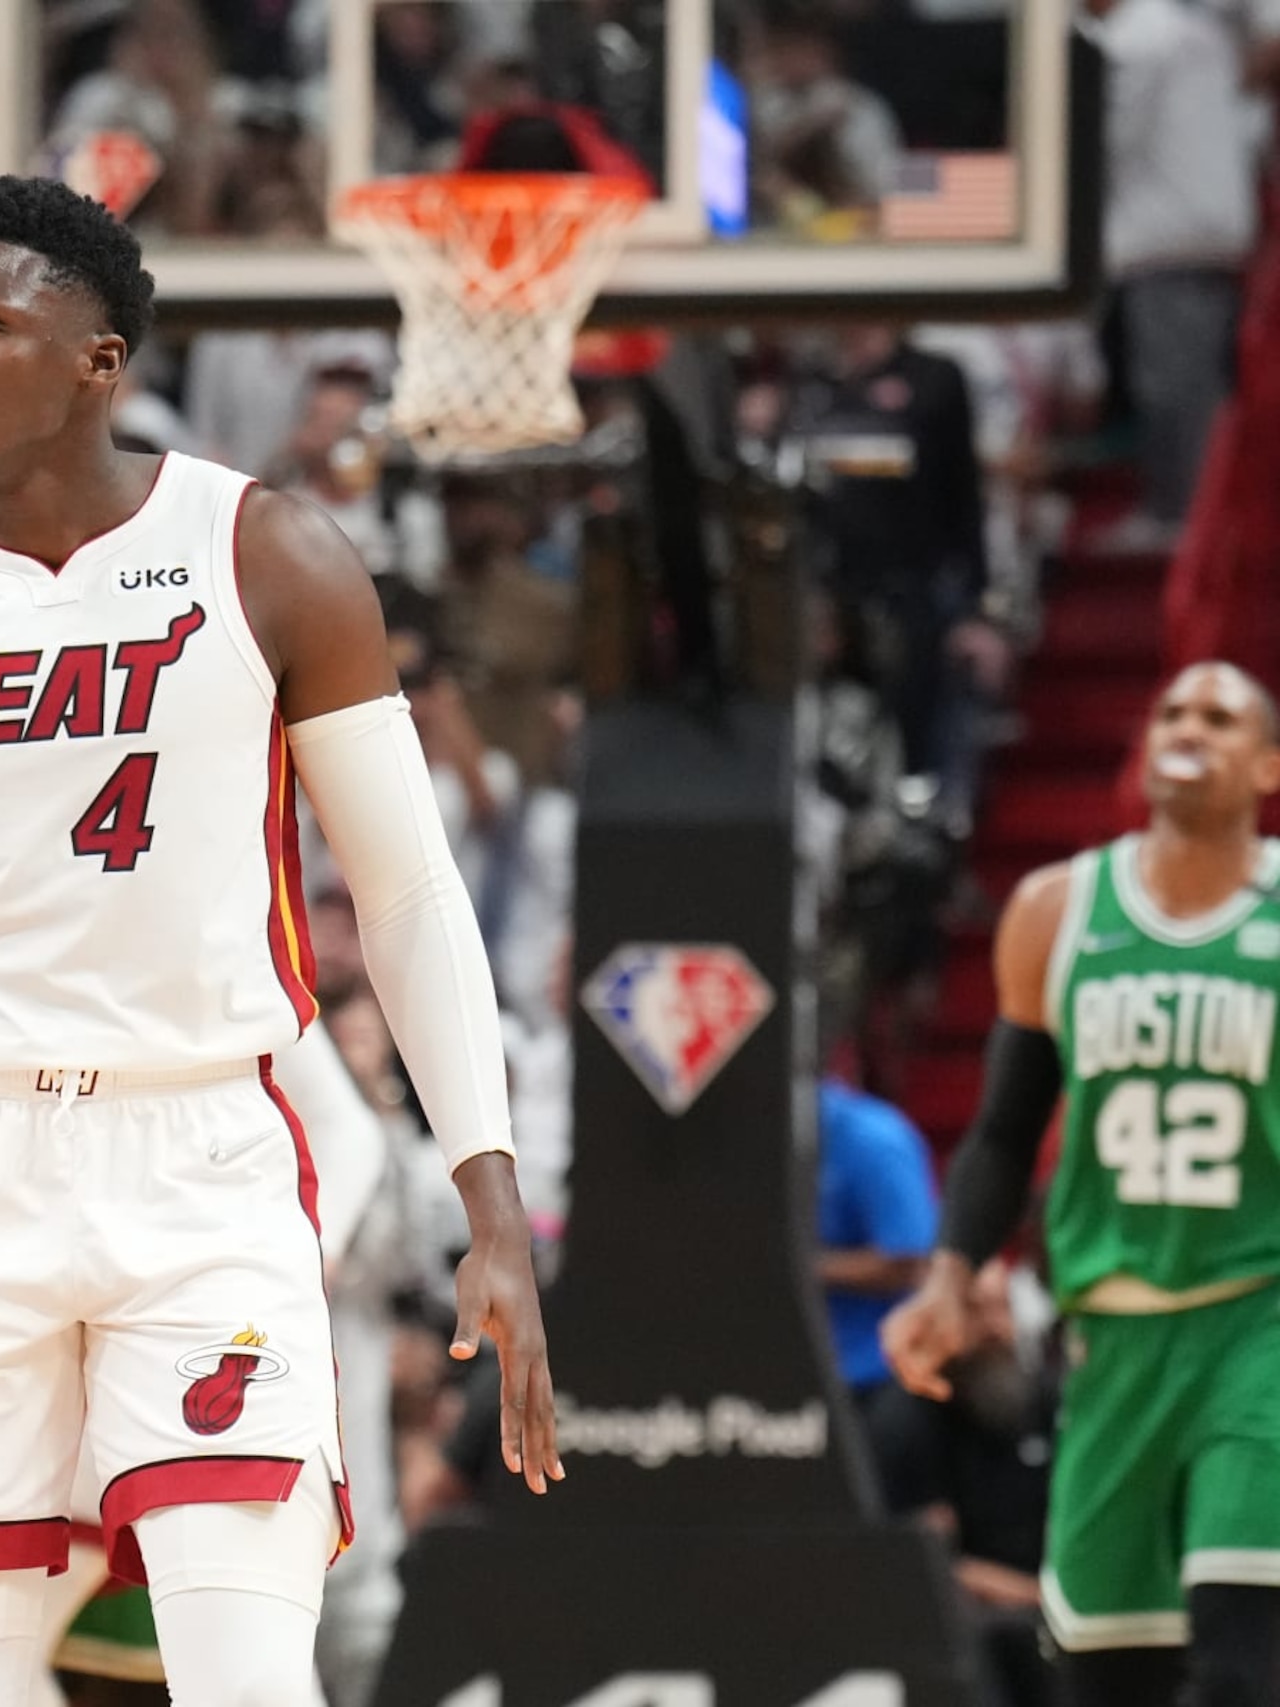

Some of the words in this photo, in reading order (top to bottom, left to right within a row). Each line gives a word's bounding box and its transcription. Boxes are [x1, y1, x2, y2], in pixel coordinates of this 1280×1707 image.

[70, 751, 159, 872] 4
[1074, 970, 1277, 1086] BOSTON
[1094, 1078, 1248, 1209] 42
[707, 1394, 829, 1459] Pixel
